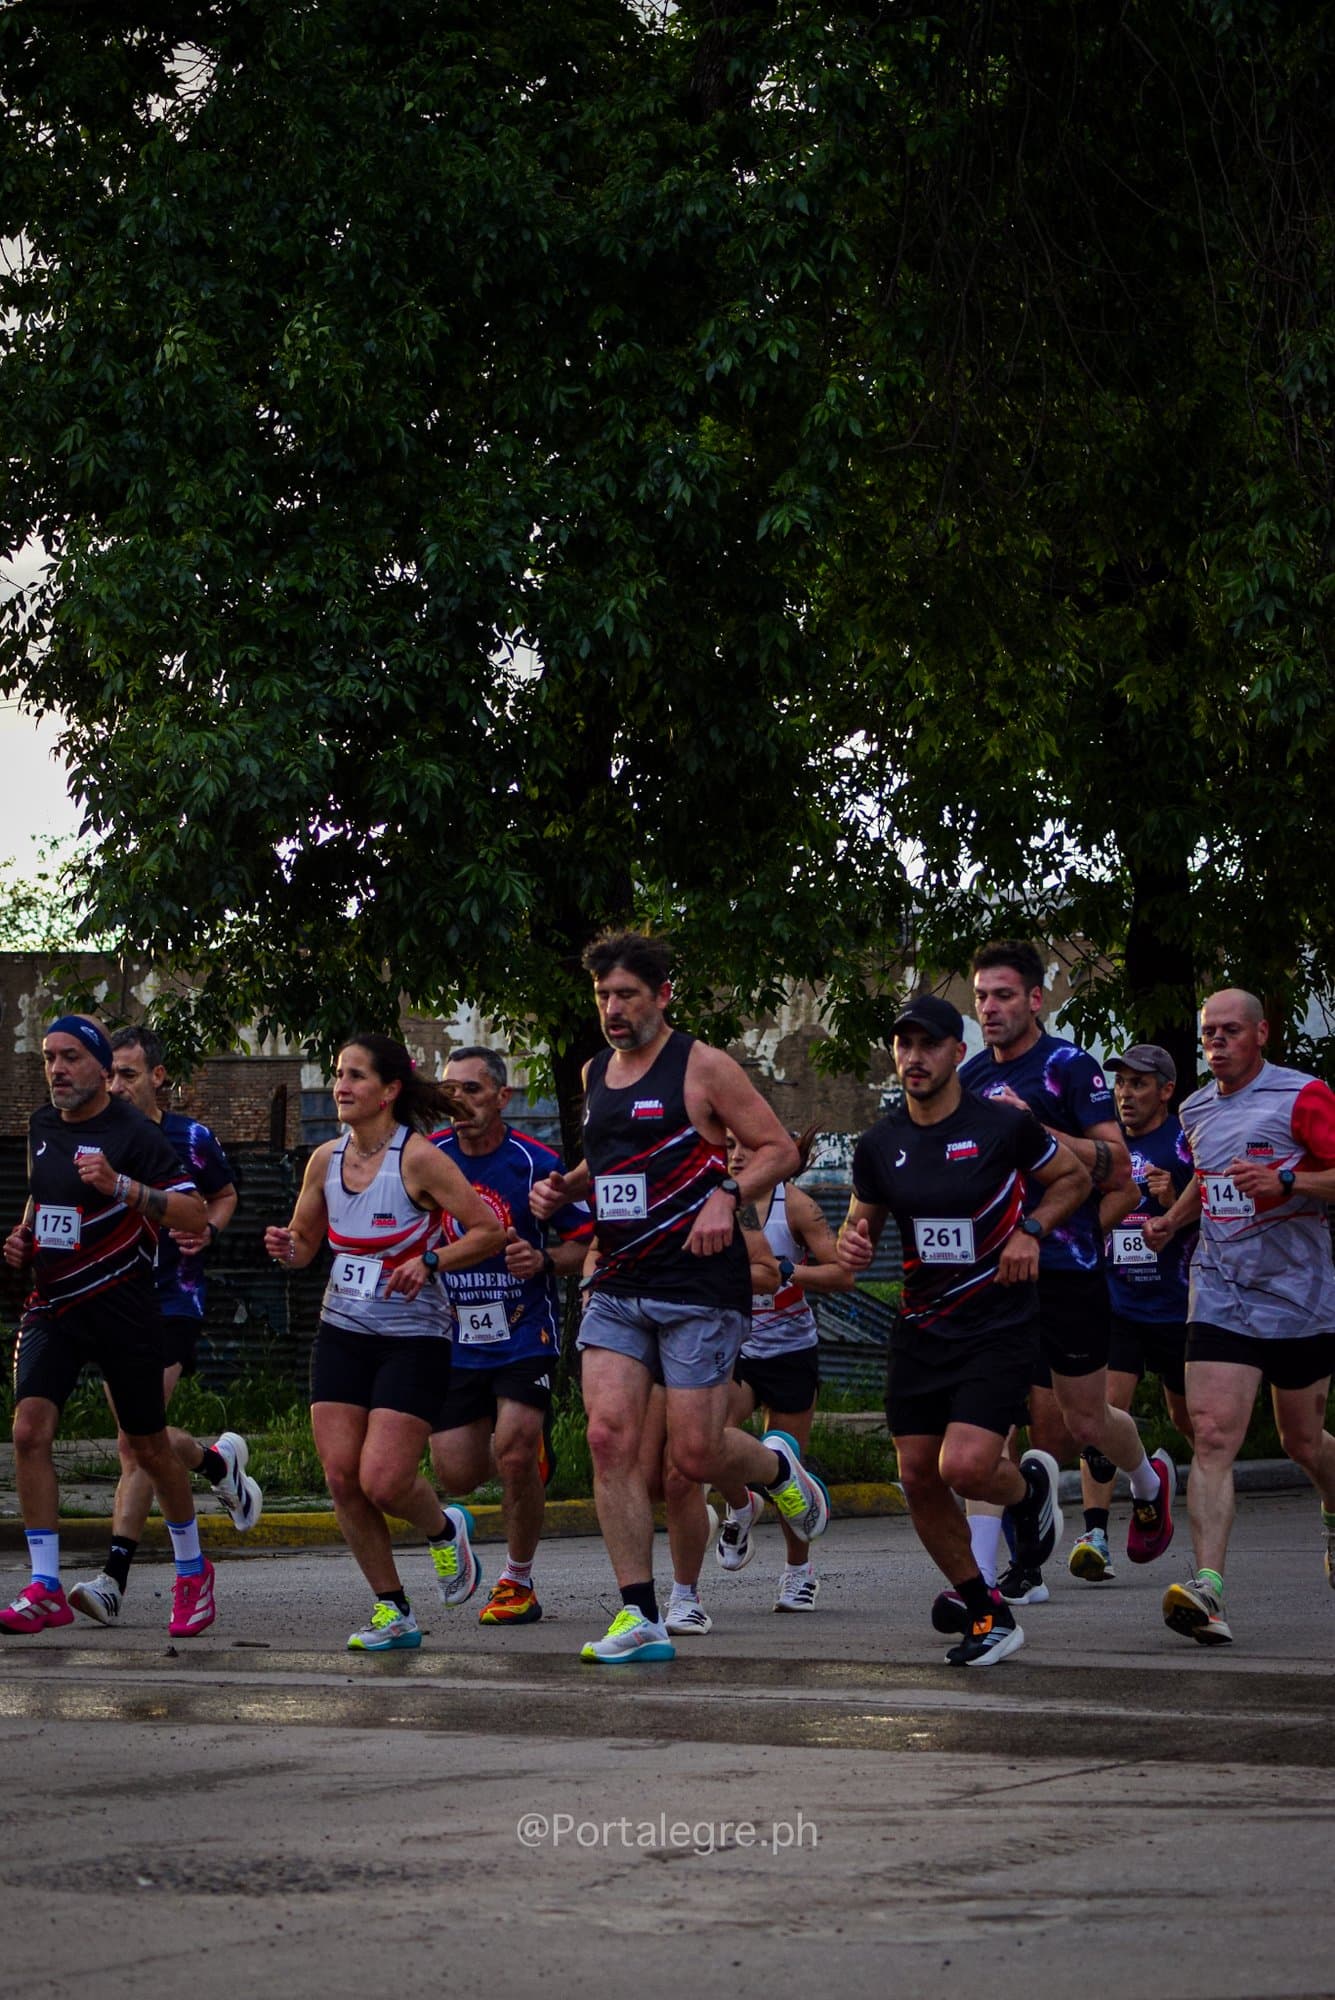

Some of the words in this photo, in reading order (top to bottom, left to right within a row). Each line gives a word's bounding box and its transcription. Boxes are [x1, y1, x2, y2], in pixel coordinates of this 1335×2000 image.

[602, 1184, 637, 1203] 129
[42, 1214, 72, 1234] 175
[923, 1228, 961, 1247] 261
[1123, 1236, 1143, 1252] 68
[343, 1264, 365, 1284] 51
[459, 1290, 522, 1301] MOVIMIENTO
[470, 1313, 493, 1330] 64
